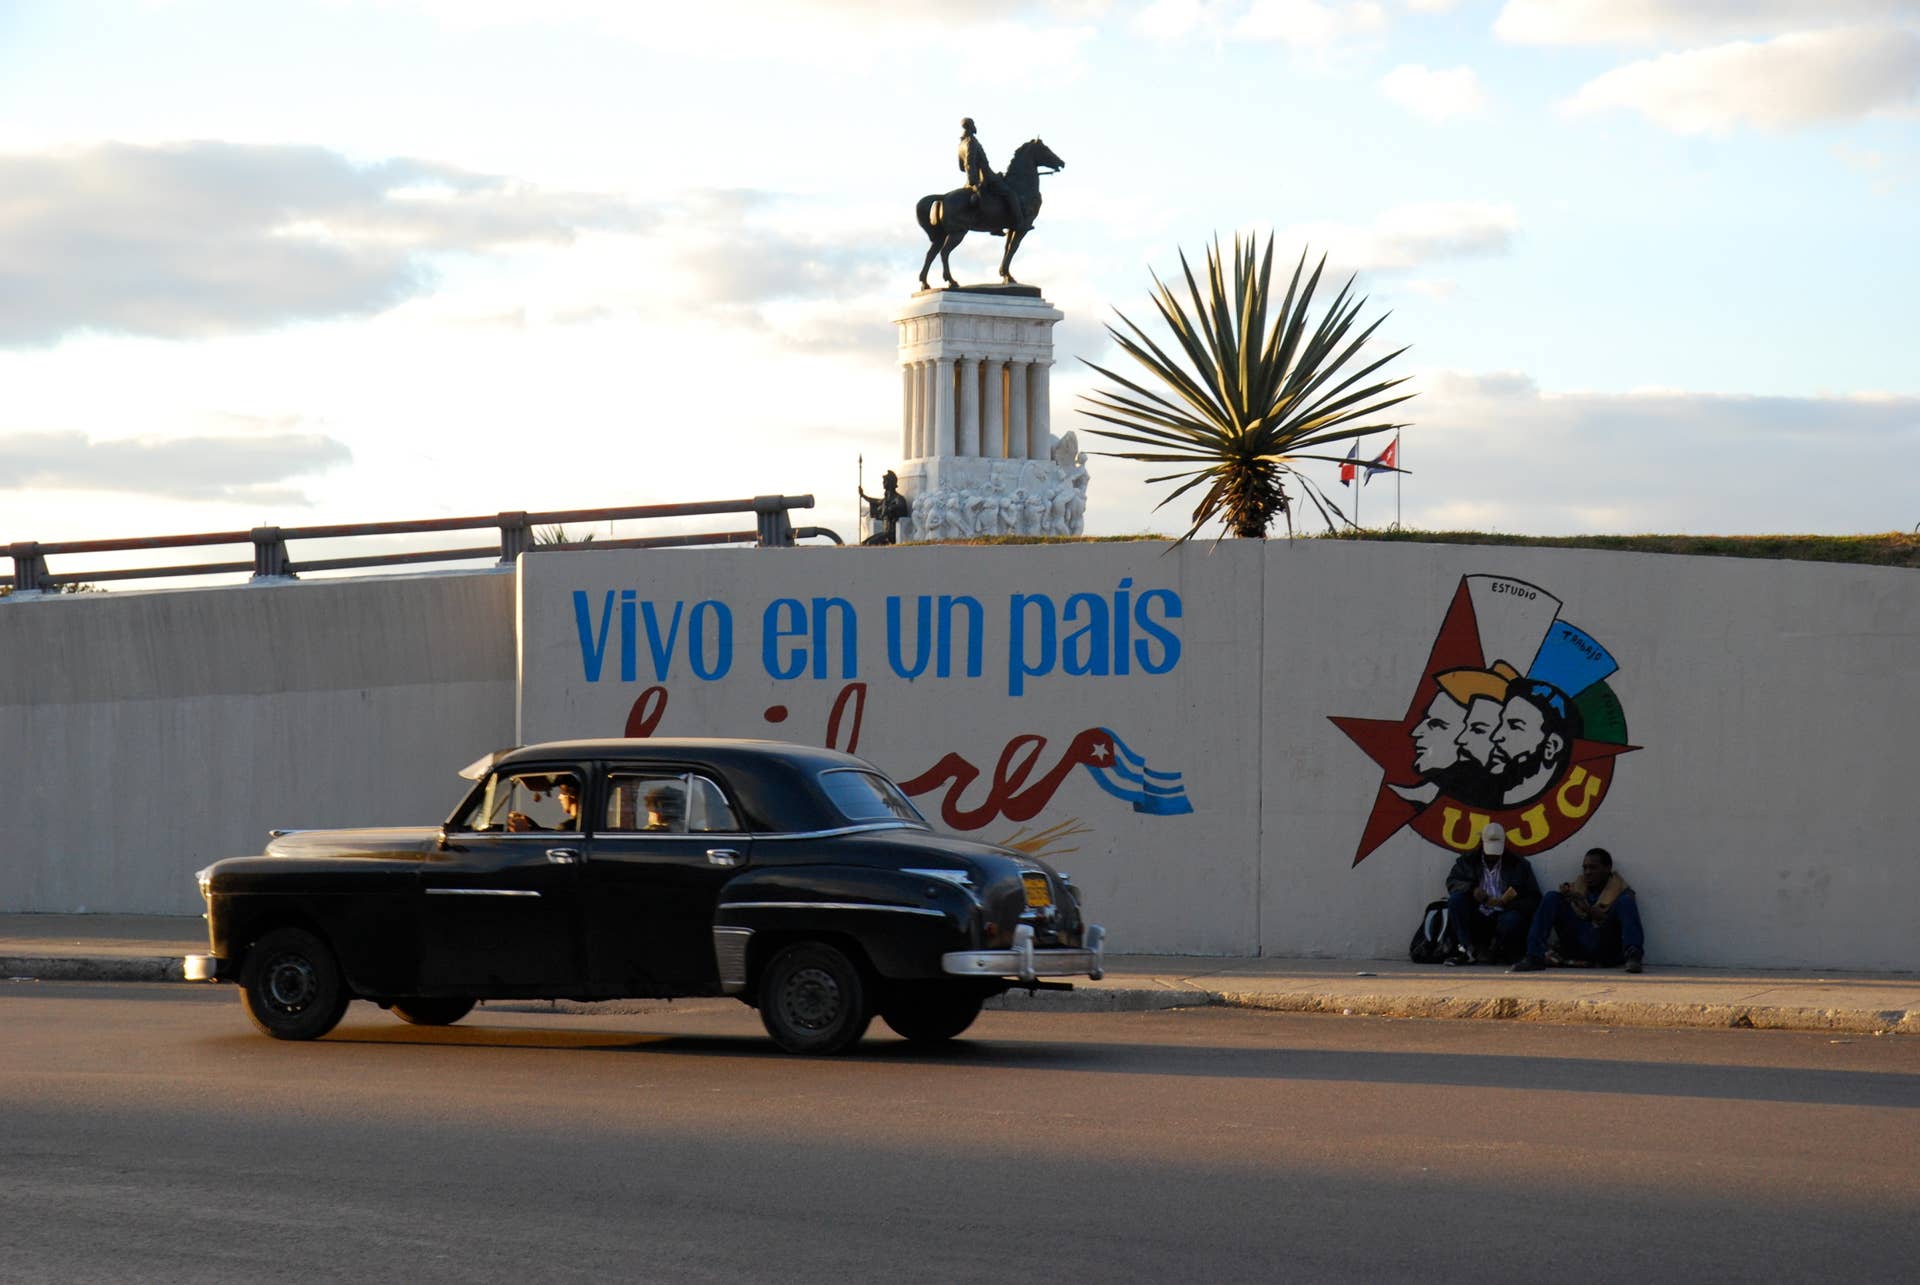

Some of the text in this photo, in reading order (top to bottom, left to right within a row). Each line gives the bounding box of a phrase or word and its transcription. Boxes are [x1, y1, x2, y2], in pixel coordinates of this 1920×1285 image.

[572, 577, 1183, 697] Vivo en un país
[1442, 765, 1602, 850] UJC
